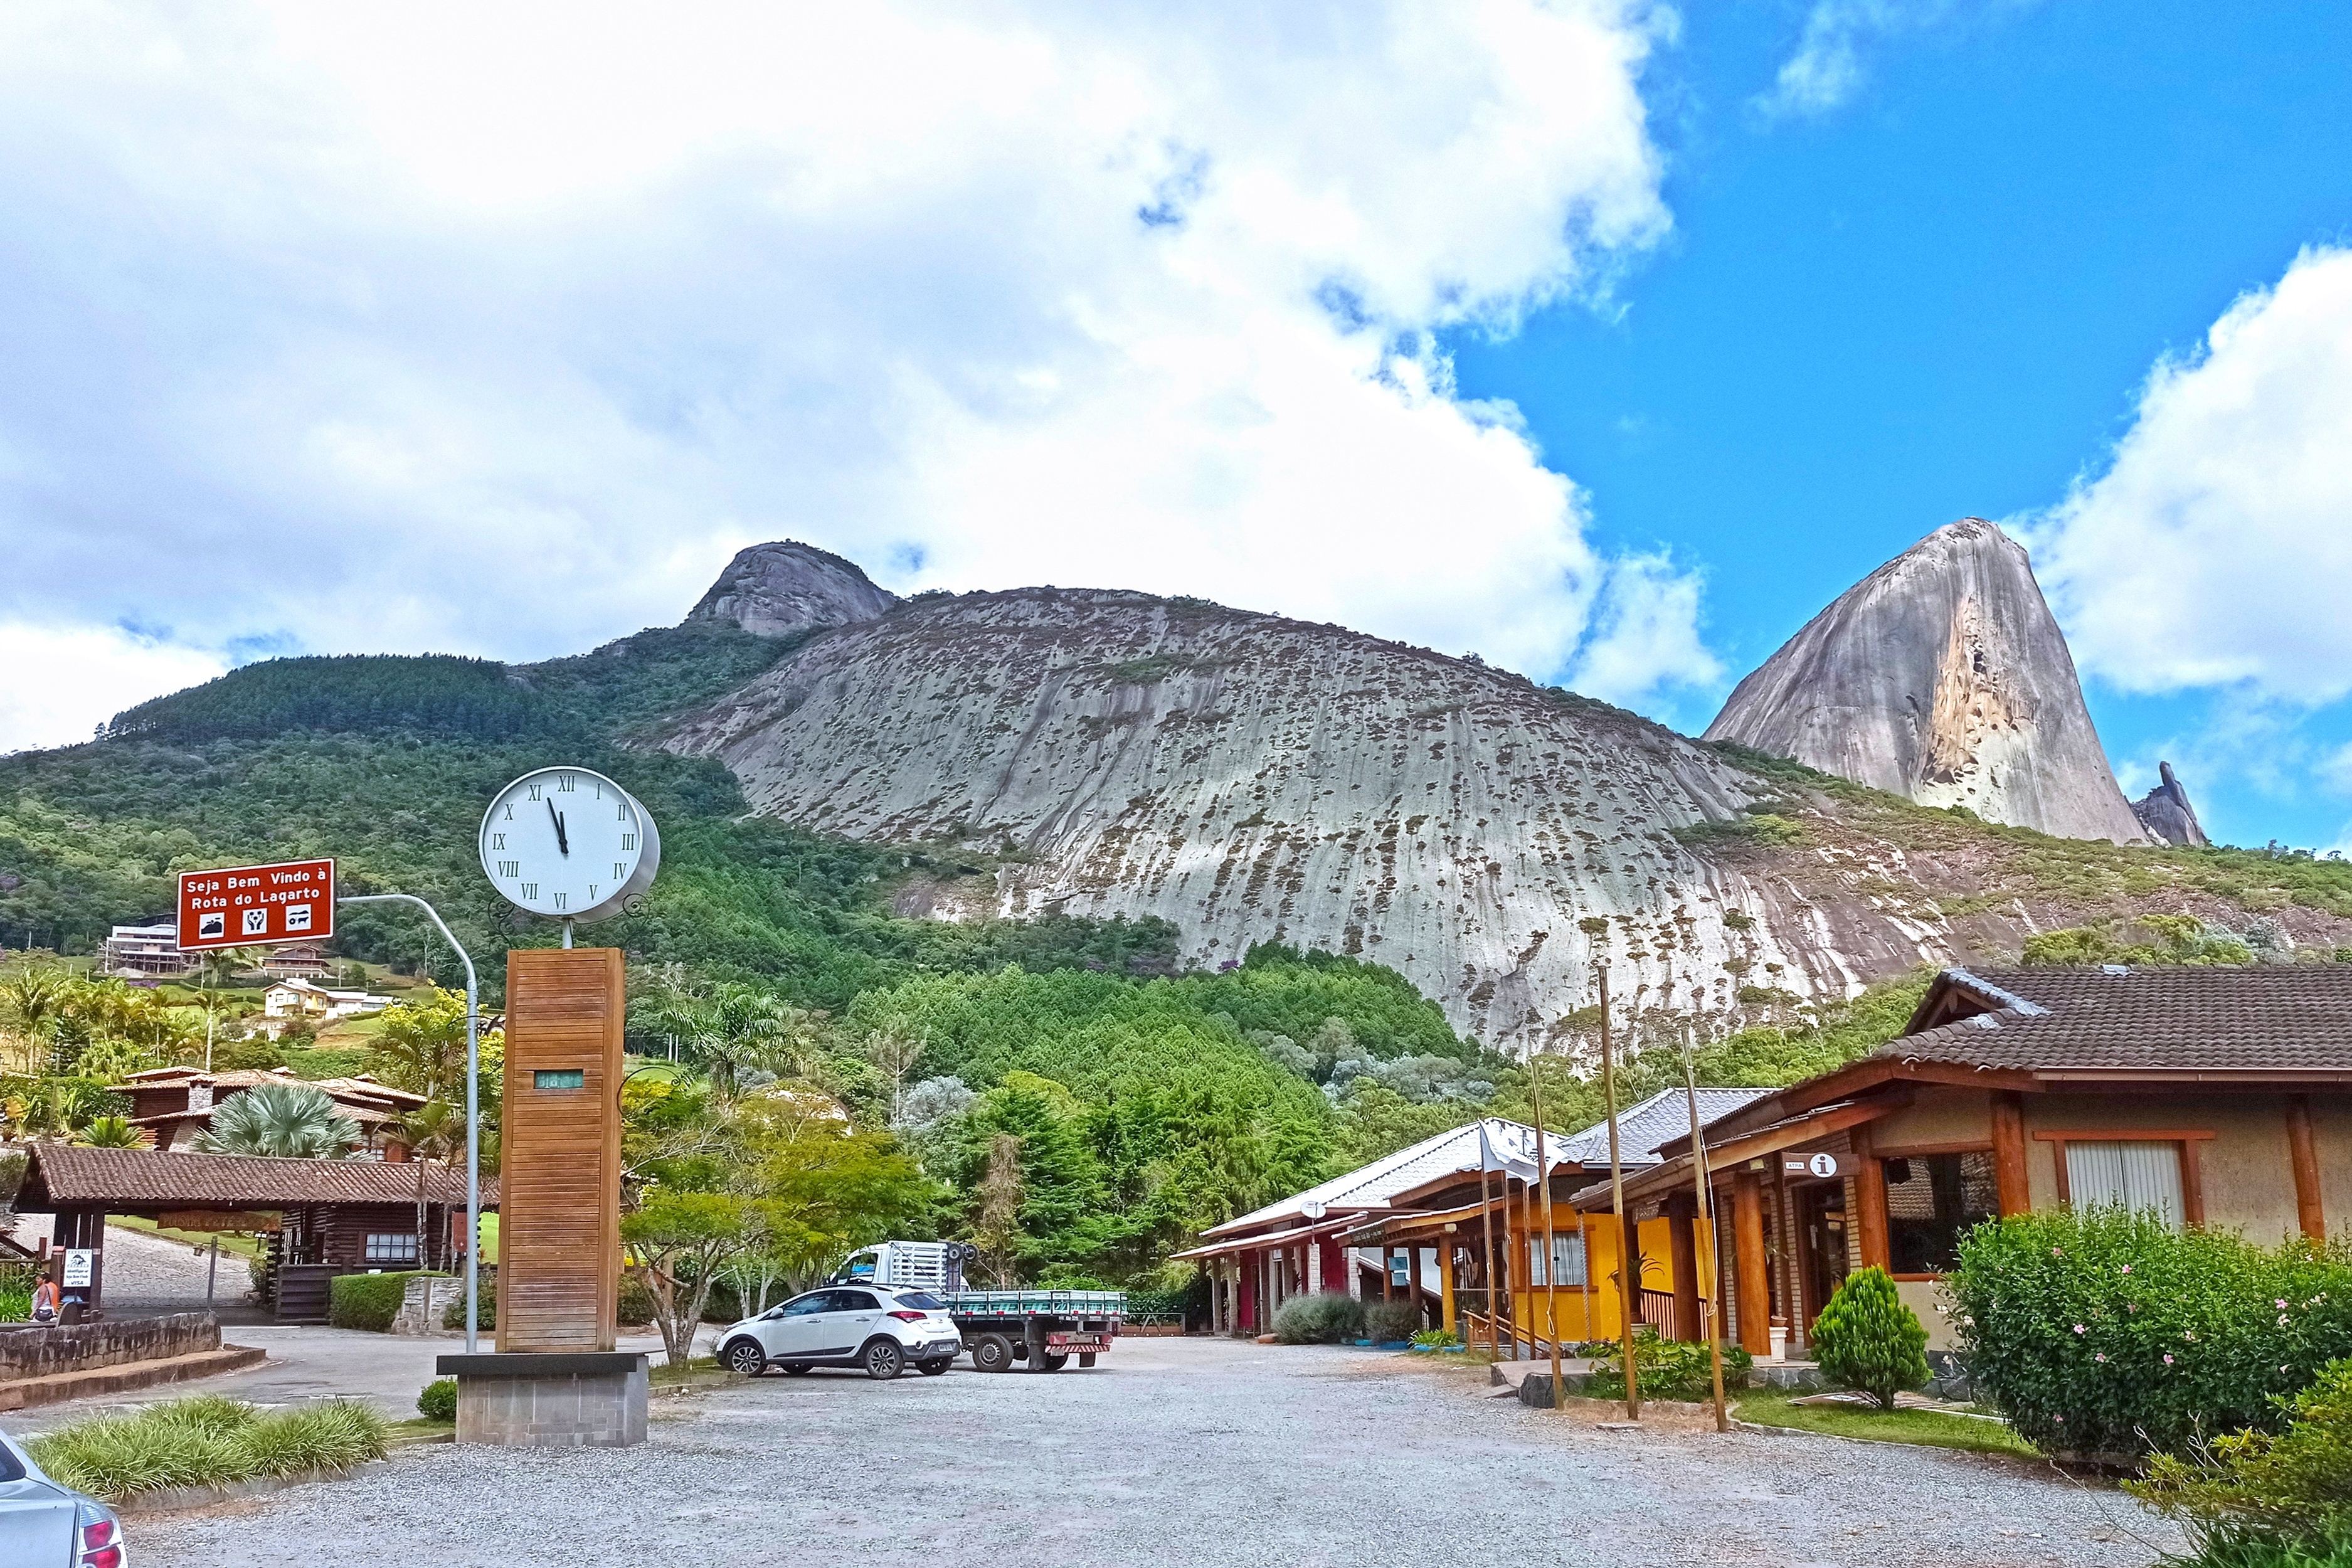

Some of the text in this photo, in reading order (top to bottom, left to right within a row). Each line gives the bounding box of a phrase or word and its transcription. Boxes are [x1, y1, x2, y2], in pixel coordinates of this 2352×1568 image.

[558, 775, 575, 792] XII
[596, 783, 601, 800] I
[528, 785, 542, 802] XI
[504, 803, 514, 820] X
[617, 804, 627, 821] II
[492, 833, 506, 850] IX
[622, 834, 635, 850] III
[497, 861, 519, 877] VIII
[613, 862, 627, 879] IV
[187, 867, 326, 895] Seja Bem Vindo à
[191, 887, 319, 909] Rota do Lagarto
[521, 883, 538, 899] VII
[589, 884, 598, 901] V
[554, 893, 567, 909] VI
